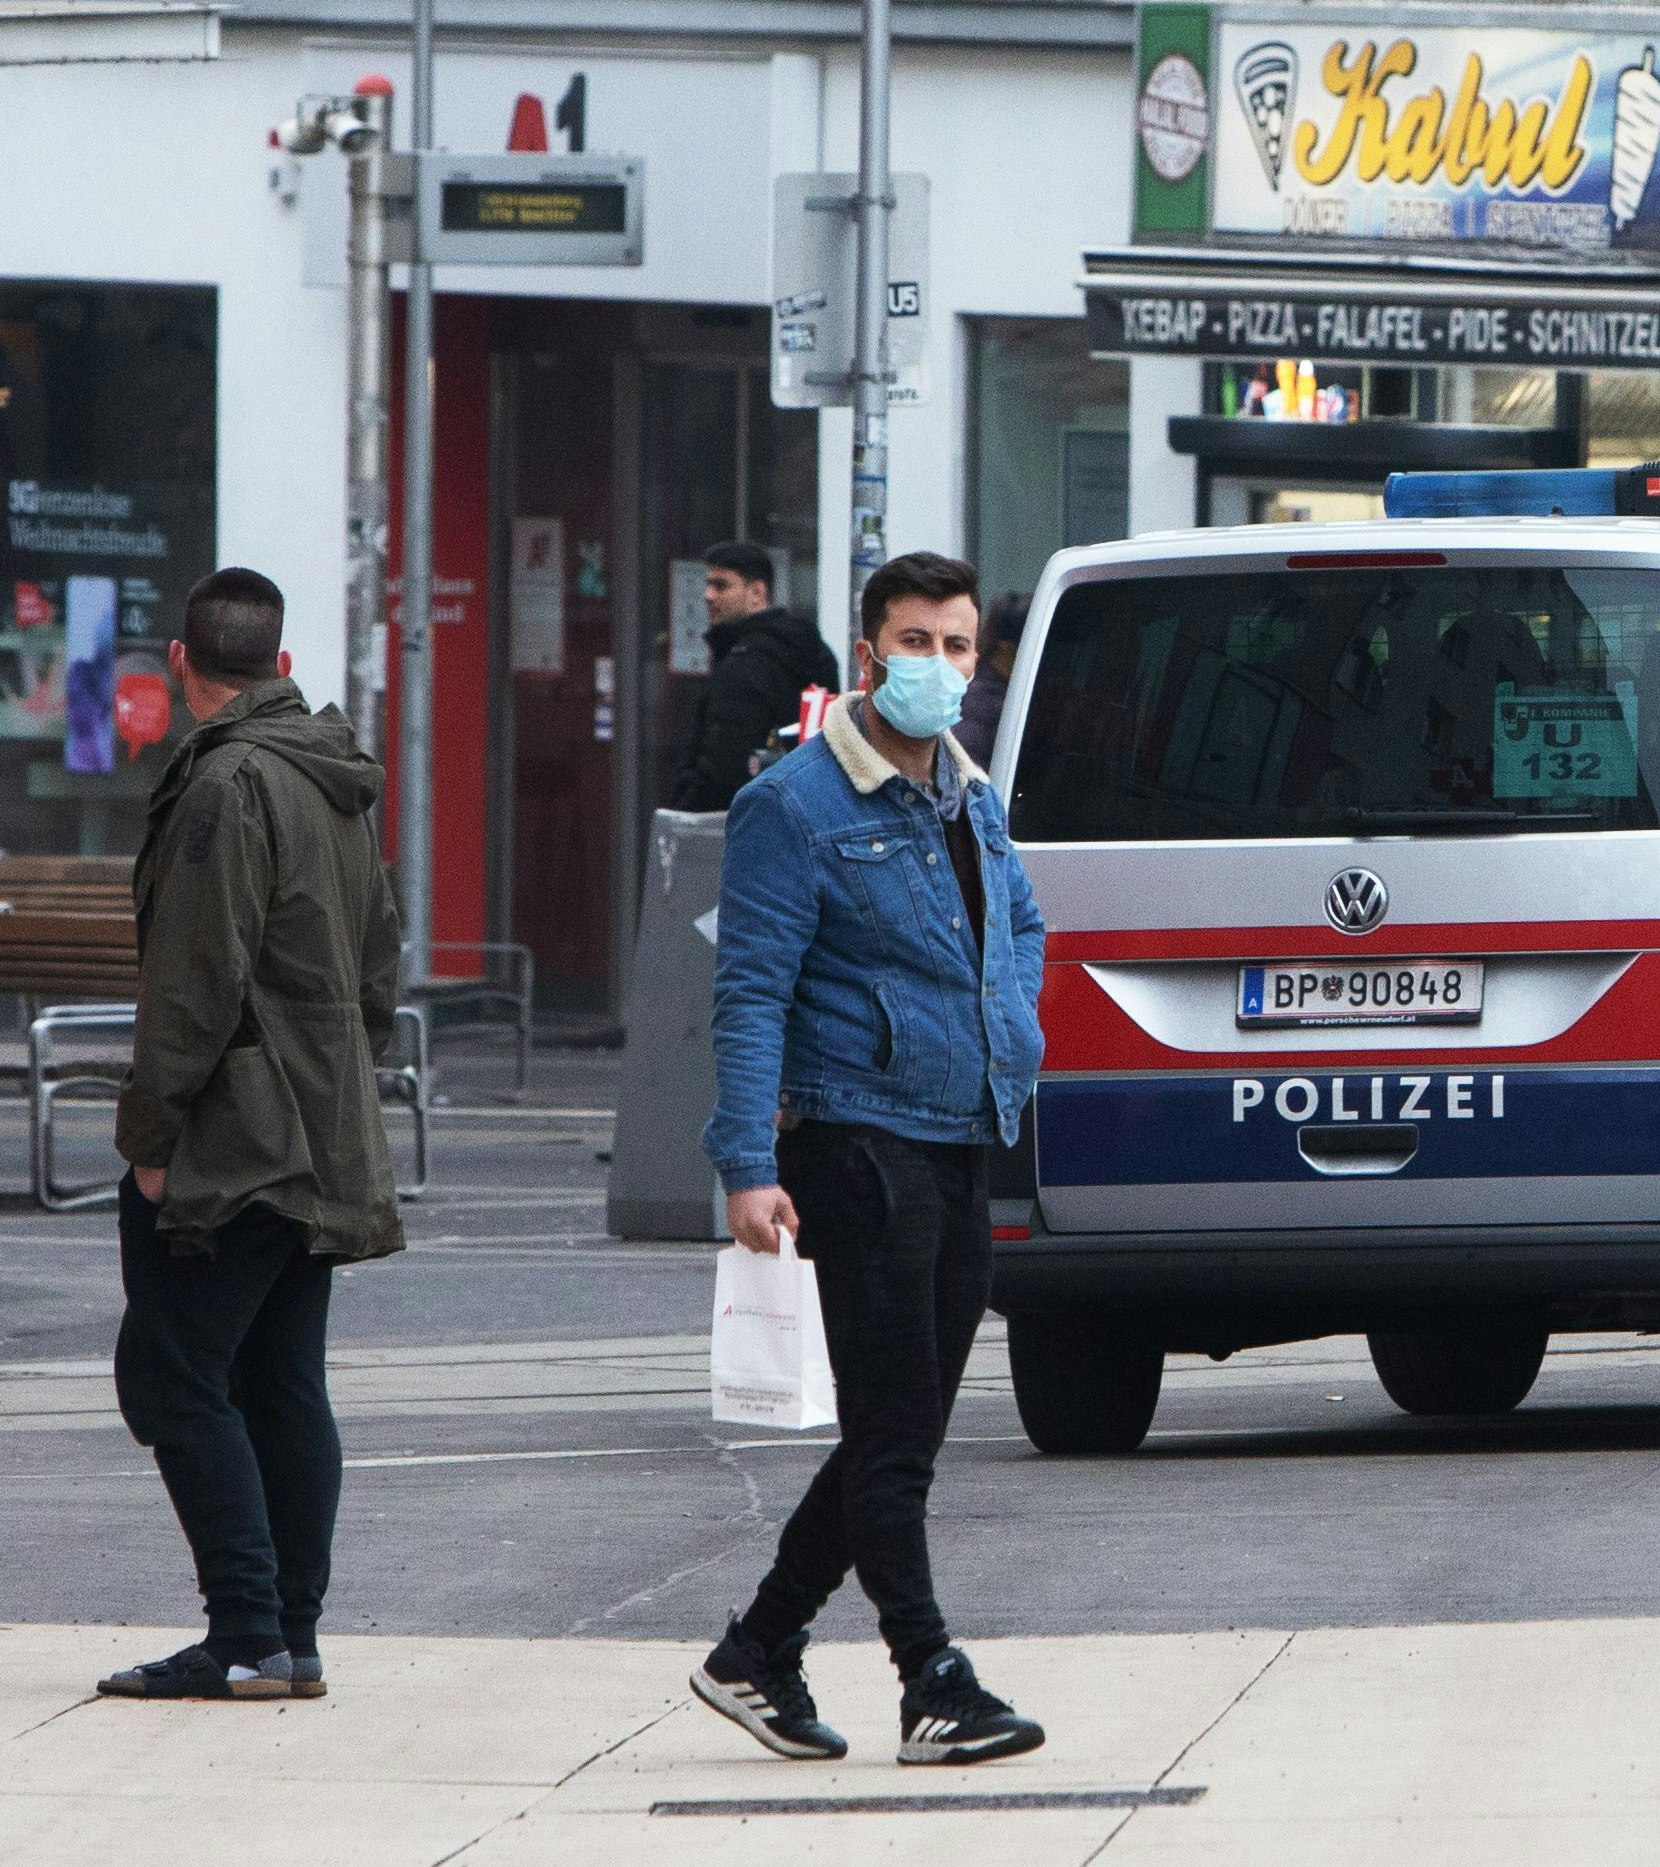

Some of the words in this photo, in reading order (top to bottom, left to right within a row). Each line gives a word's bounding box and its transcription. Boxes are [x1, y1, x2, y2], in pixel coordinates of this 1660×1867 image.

[1294, 40, 1592, 189] Kabul
[1122, 299, 1206, 343] KEBAP
[1227, 301, 1298, 345] PIZZA
[1318, 304, 1428, 351] FALAFEL
[1449, 310, 1509, 351] PIDE
[1544, 723, 1582, 748] U
[1522, 752, 1602, 780] 132
[1275, 973, 1318, 1008] BP
[1348, 970, 1462, 1007] 90848
[1233, 1074, 1505, 1122] POLIZEI
